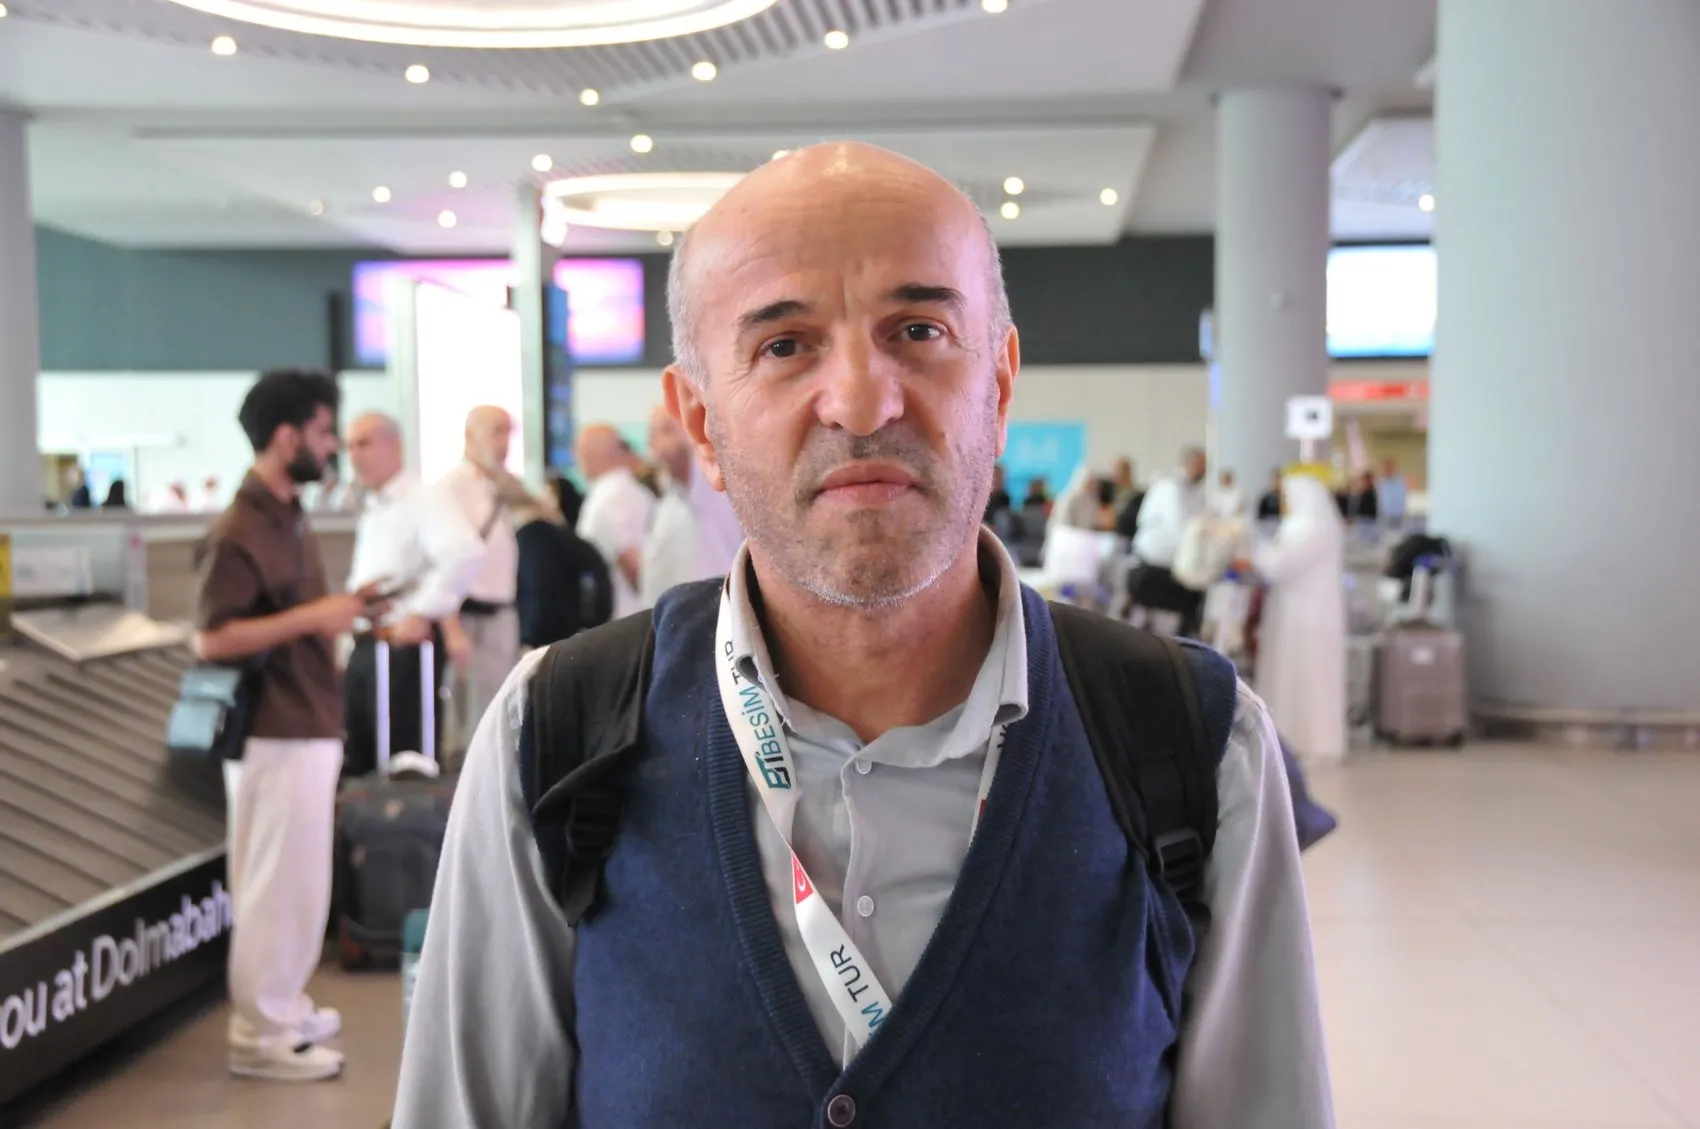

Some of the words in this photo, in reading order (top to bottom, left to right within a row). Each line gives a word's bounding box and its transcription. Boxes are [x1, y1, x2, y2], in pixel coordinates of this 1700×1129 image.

[724, 640, 742, 684] TR
[830, 943, 869, 1003] TUR
[0, 981, 48, 1049] ou
[51, 950, 89, 1022] at
[861, 1001, 884, 1030] M
